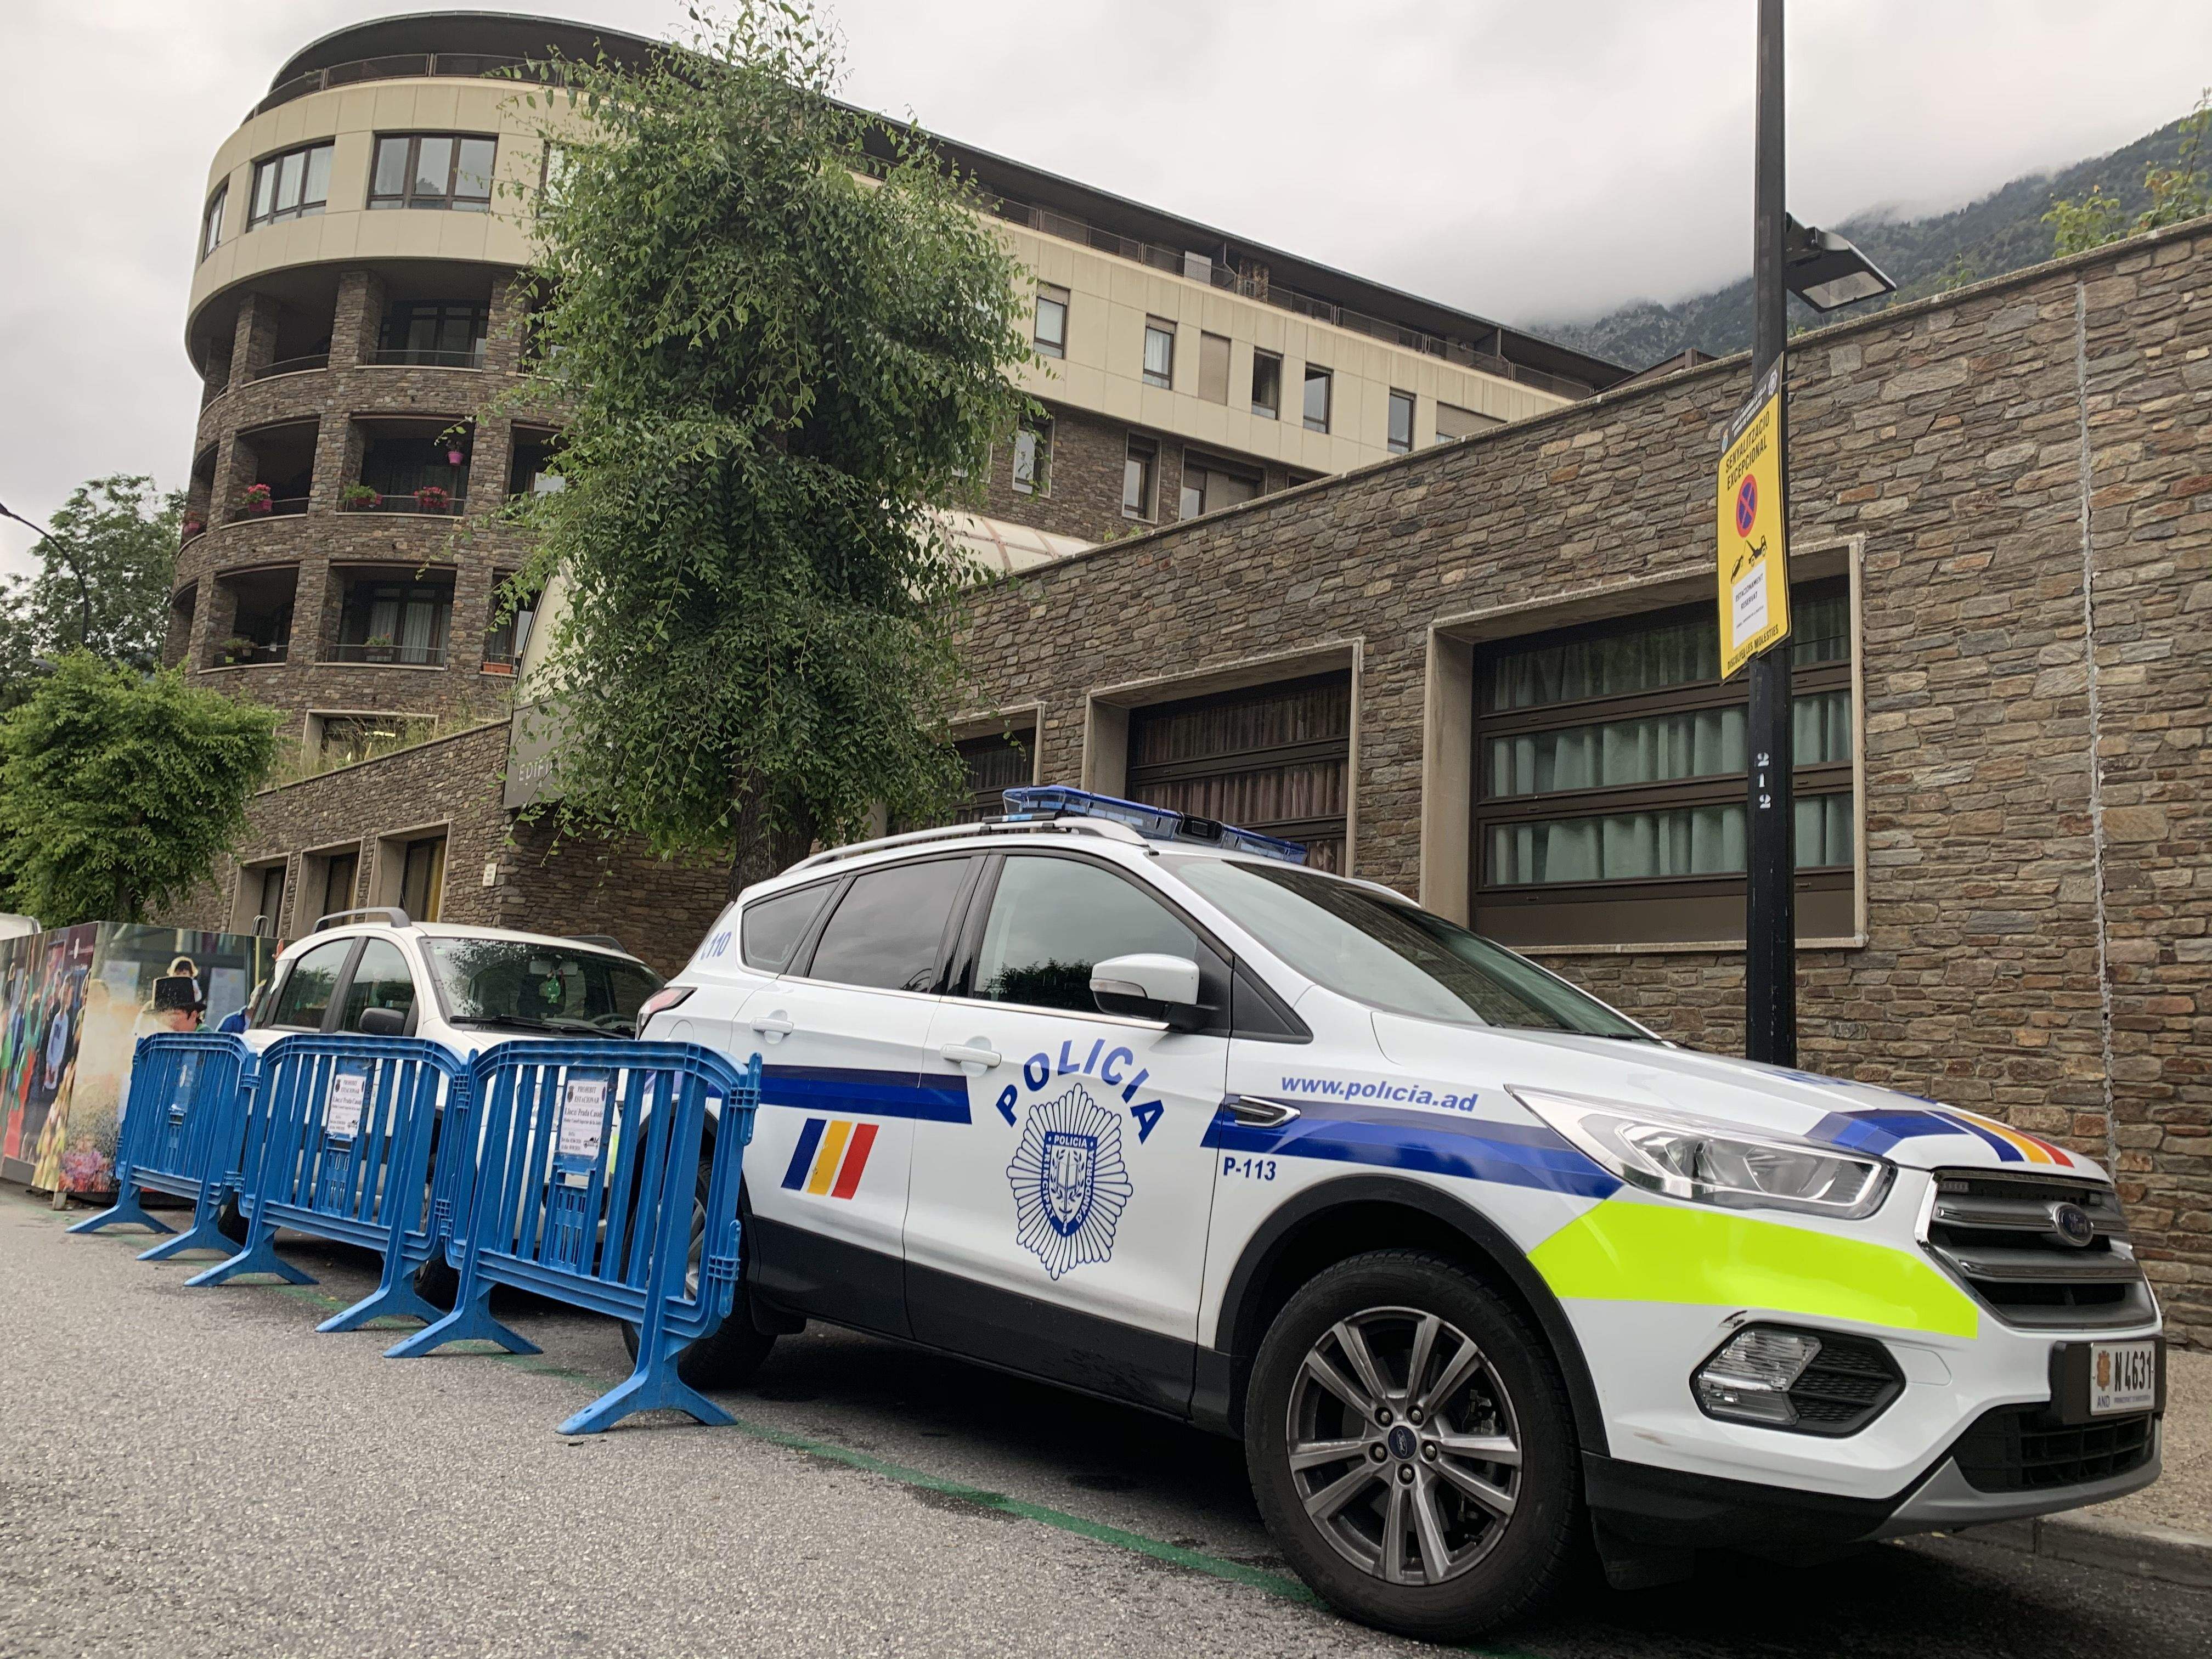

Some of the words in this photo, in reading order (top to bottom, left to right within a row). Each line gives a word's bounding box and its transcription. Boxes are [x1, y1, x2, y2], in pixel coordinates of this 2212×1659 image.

[1726, 408, 1770, 473] SENYALITZACIÓ
[1728, 435, 1767, 491] EXCEPCIONAL
[1736, 573, 1763, 602] ESTACIONAMENT
[1741, 591, 1758, 610] RESERVAT
[1754, 624, 1779, 648] MOLESTIES
[574, 1096, 600, 1104] ESTACIONAR
[577, 1086, 596, 1094] PROHIBIT
[996, 1038, 1164, 1145] POLICIA
[1282, 1077, 1479, 1112] www.policia.ad
[578, 1108, 590, 1117] Prada
[1054, 1134, 1087, 1148] POLICIA
[1223, 1157, 1277, 1181] P-113
[1042, 1144, 1056, 1220] PRINCIPAT
[1076, 1149, 1094, 1223] D'ANDORRA
[2097, 1395, 2111, 1408] AND
